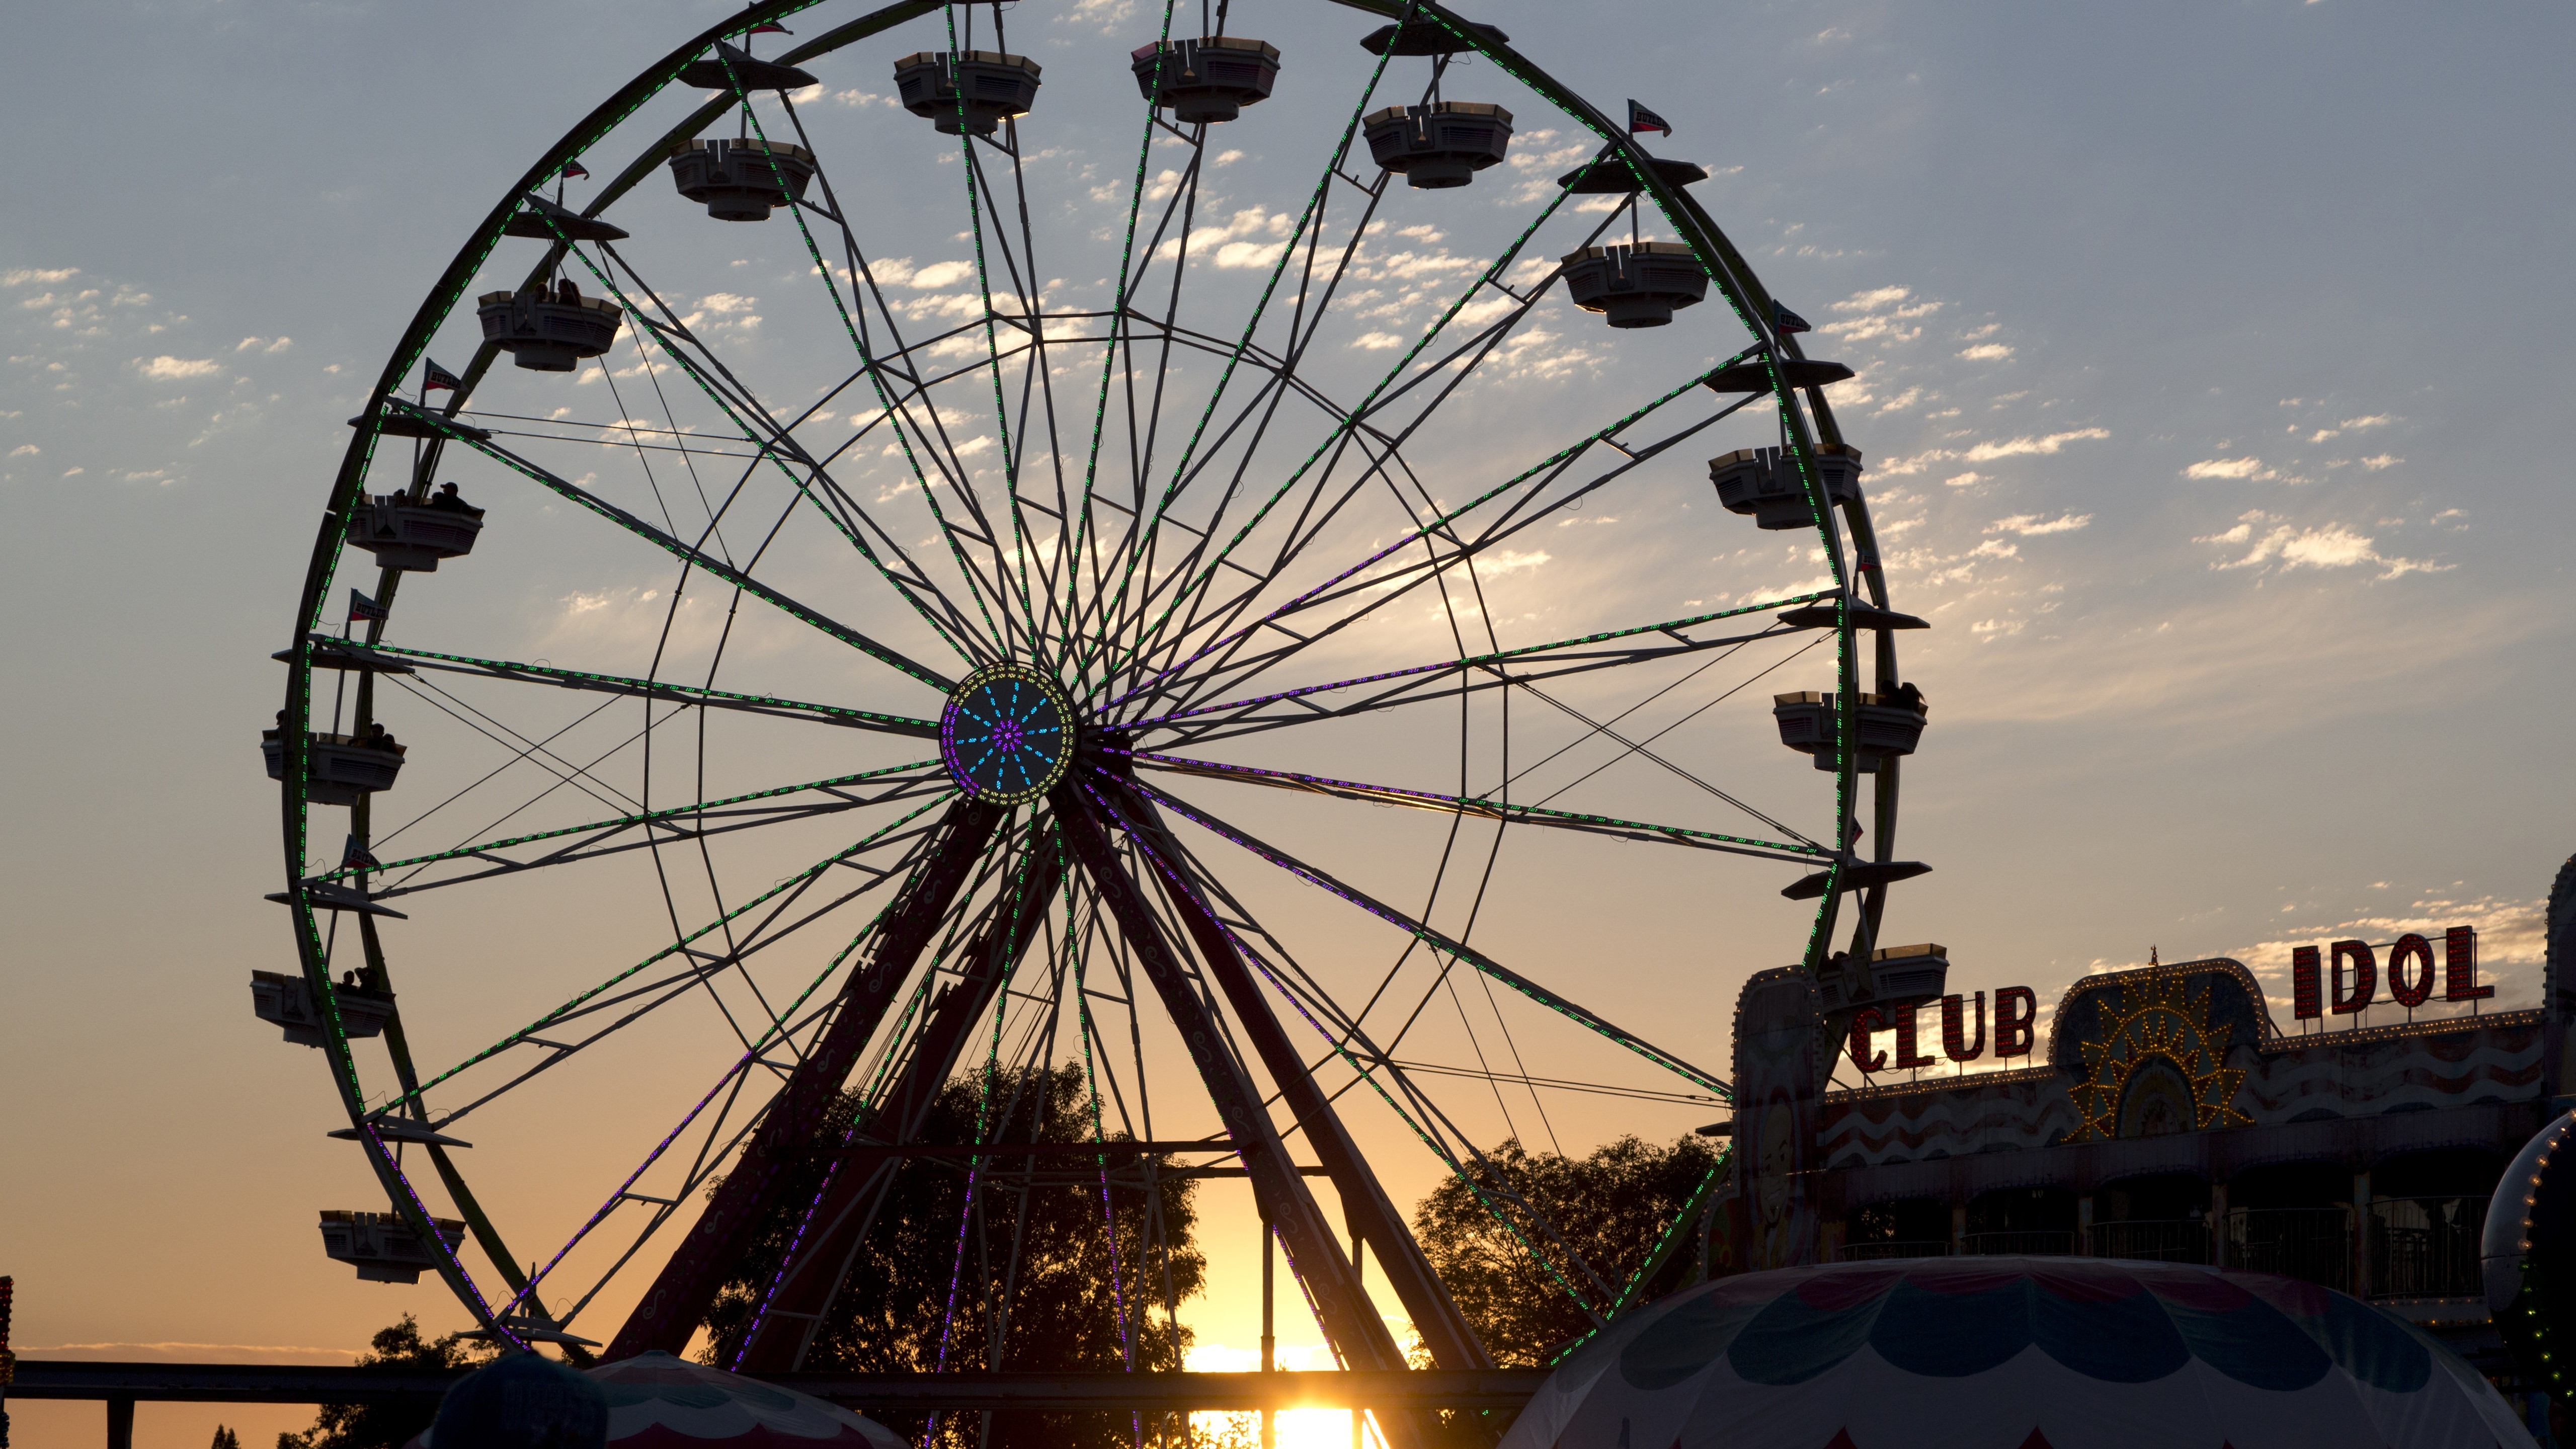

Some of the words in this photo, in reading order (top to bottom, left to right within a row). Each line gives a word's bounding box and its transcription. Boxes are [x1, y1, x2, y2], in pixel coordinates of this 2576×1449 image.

[1436, 103, 1443, 111] 8
[431, 371, 462, 389] BUTLER
[356, 602, 386, 618] BUTLER
[1850, 986, 2037, 1073] CLUB
[2293, 926, 2494, 1020] IDOL
[381, 1214, 390, 1222] 20
